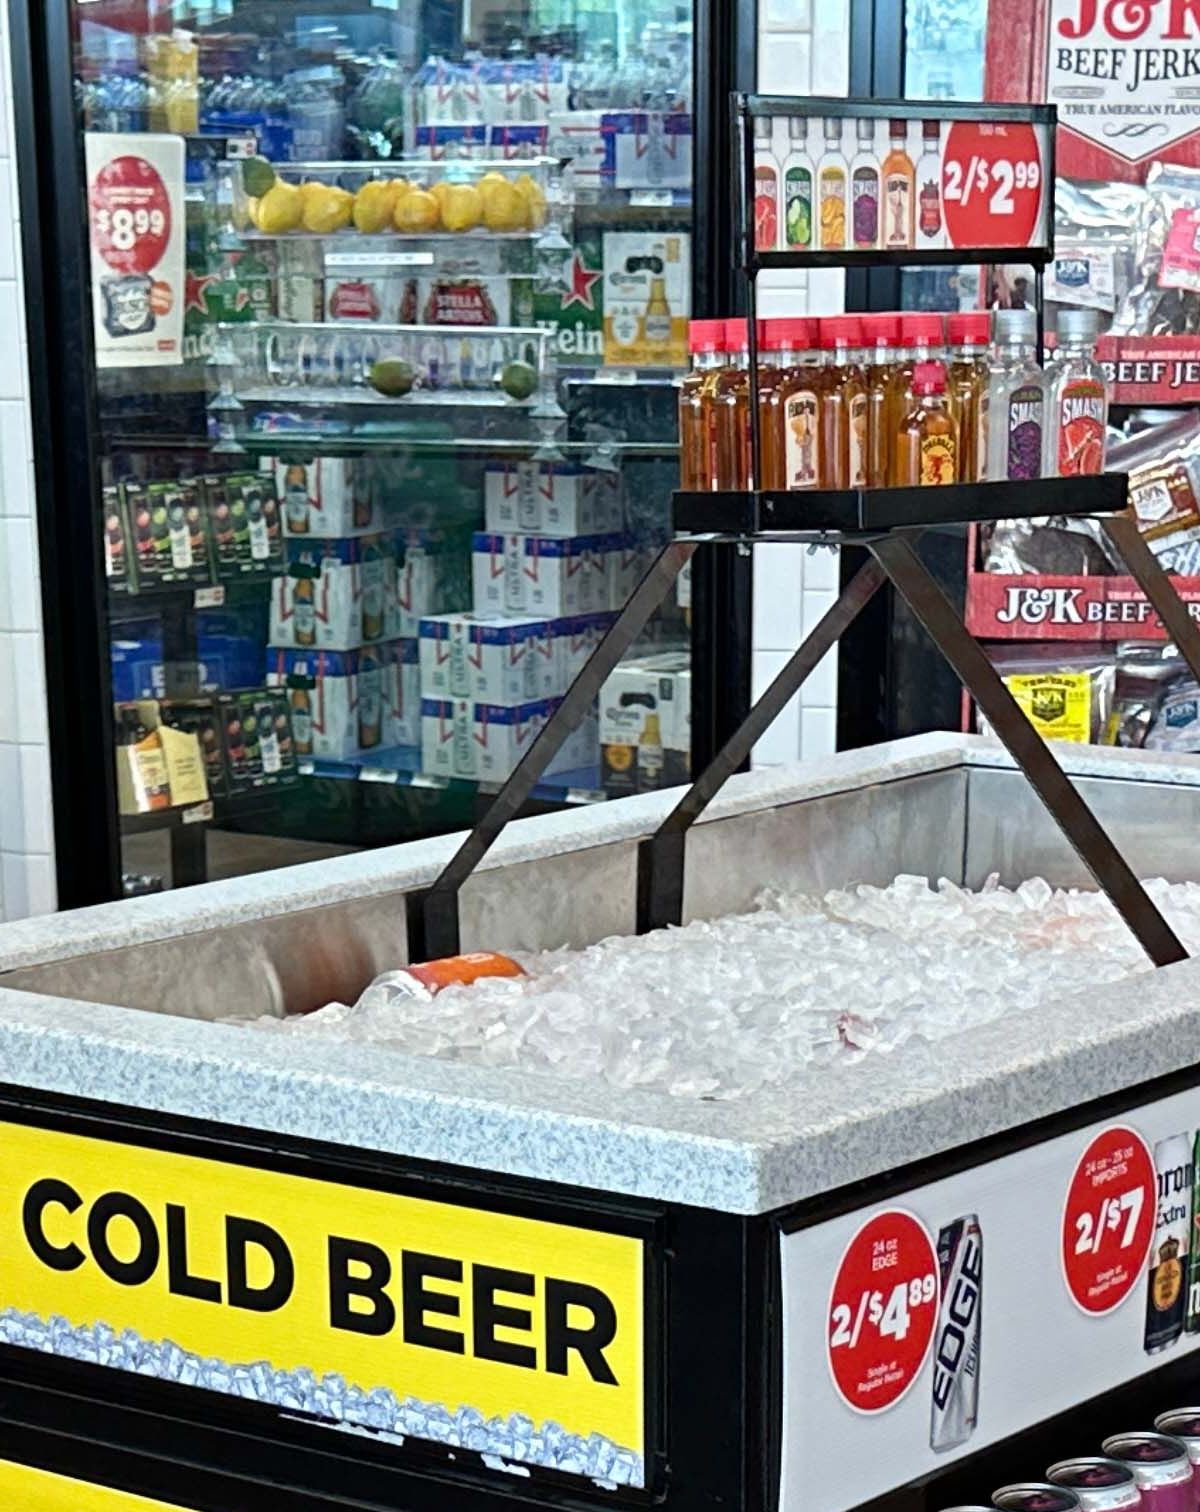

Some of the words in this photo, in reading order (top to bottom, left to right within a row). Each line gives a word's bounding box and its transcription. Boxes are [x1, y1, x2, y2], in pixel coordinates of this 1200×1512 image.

[1056, 48, 1127, 81] BEEF
[1065, 104, 1096, 116] TRUE
[1099, 104, 1161, 116] AMERICAN
[1101, 361, 1167, 382] BEEF
[996, 587, 1084, 624] J&K
[1086, 602, 1153, 622] BEEF
[1075, 1185, 1145, 1256] 2/$7
[871, 1253, 898, 1272] EDGE
[22, 1176, 295, 1313] COLD
[328, 1234, 620, 1387] BEER
[932, 1238, 980, 1411] EDGE
